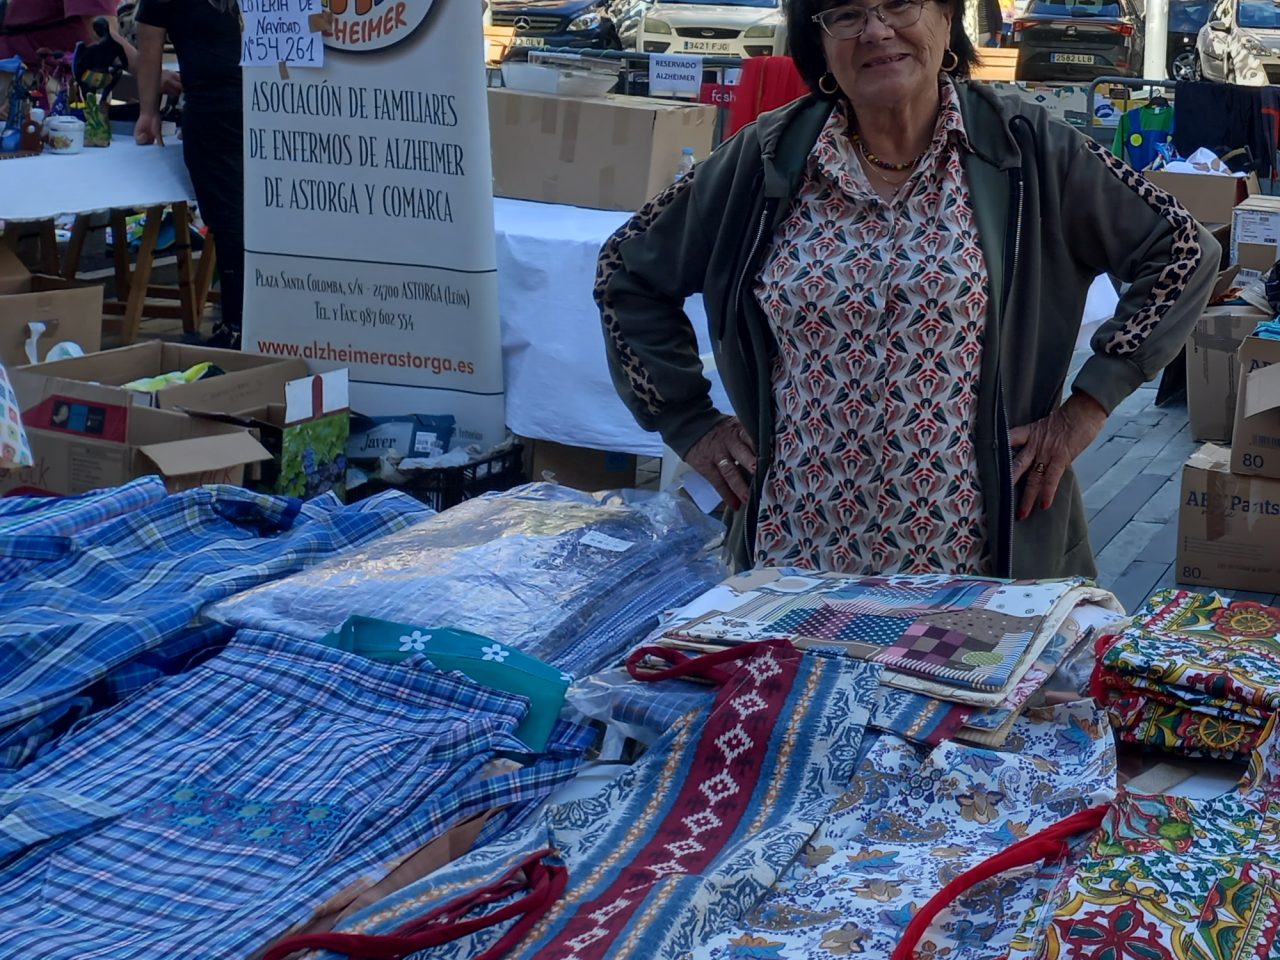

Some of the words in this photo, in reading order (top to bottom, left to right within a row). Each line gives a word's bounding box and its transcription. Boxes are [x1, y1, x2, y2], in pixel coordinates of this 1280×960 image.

[321, 1, 407, 45] HEIMER
[689, 41, 709, 51] 3421
[655, 59, 697, 69] RESERVADO
[655, 73, 696, 82] ALZHEIMER
[251, 80, 342, 117] ASOCIACIÓN
[349, 87, 368, 119] DE
[374, 89, 458, 127] FAMILIARES
[250, 127, 267, 160] DE
[273, 129, 352, 166] ENFERMOS
[359, 136, 378, 168] DE
[384, 138, 465, 176] ALZHEIMER
[264, 177, 283, 208] DE
[289, 179, 359, 214] ASTORGA
[365, 184, 376, 215] Y
[383, 186, 453, 223] COMARCA
[401, 282, 443, 303] ASTORGA
[360, 307, 376, 328] 987
[379, 308, 394, 326] 602
[257, 340, 474, 374] www.alzheimerastorga.es
[1242, 453, 1264, 469] 80
[1182, 567, 1201, 579] 80
